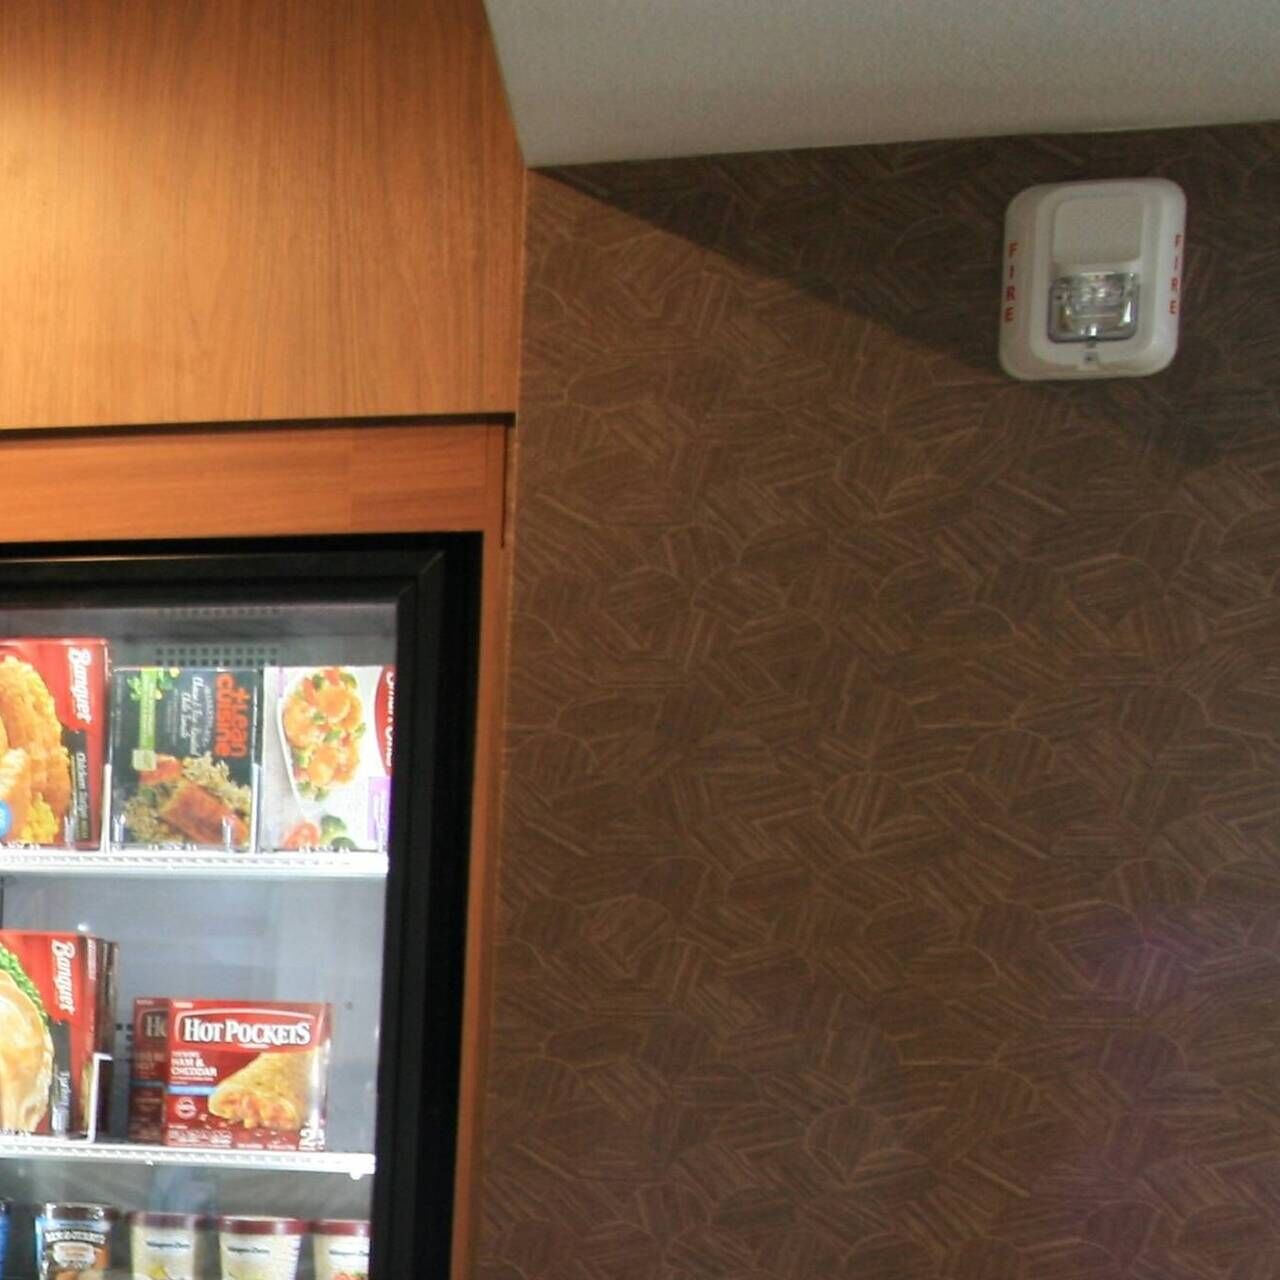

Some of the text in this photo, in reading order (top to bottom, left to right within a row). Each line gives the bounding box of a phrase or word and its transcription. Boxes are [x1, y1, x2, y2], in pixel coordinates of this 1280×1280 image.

[1003, 242, 1019, 323] FIRE
[1168, 234, 1184, 315] FIRE
[68, 646, 93, 725] Banquet
[50, 938, 77, 1015] Banquet
[183, 1017, 312, 1047] HOT POCKETS
[171, 1066, 218, 1077] CHEDDAR
